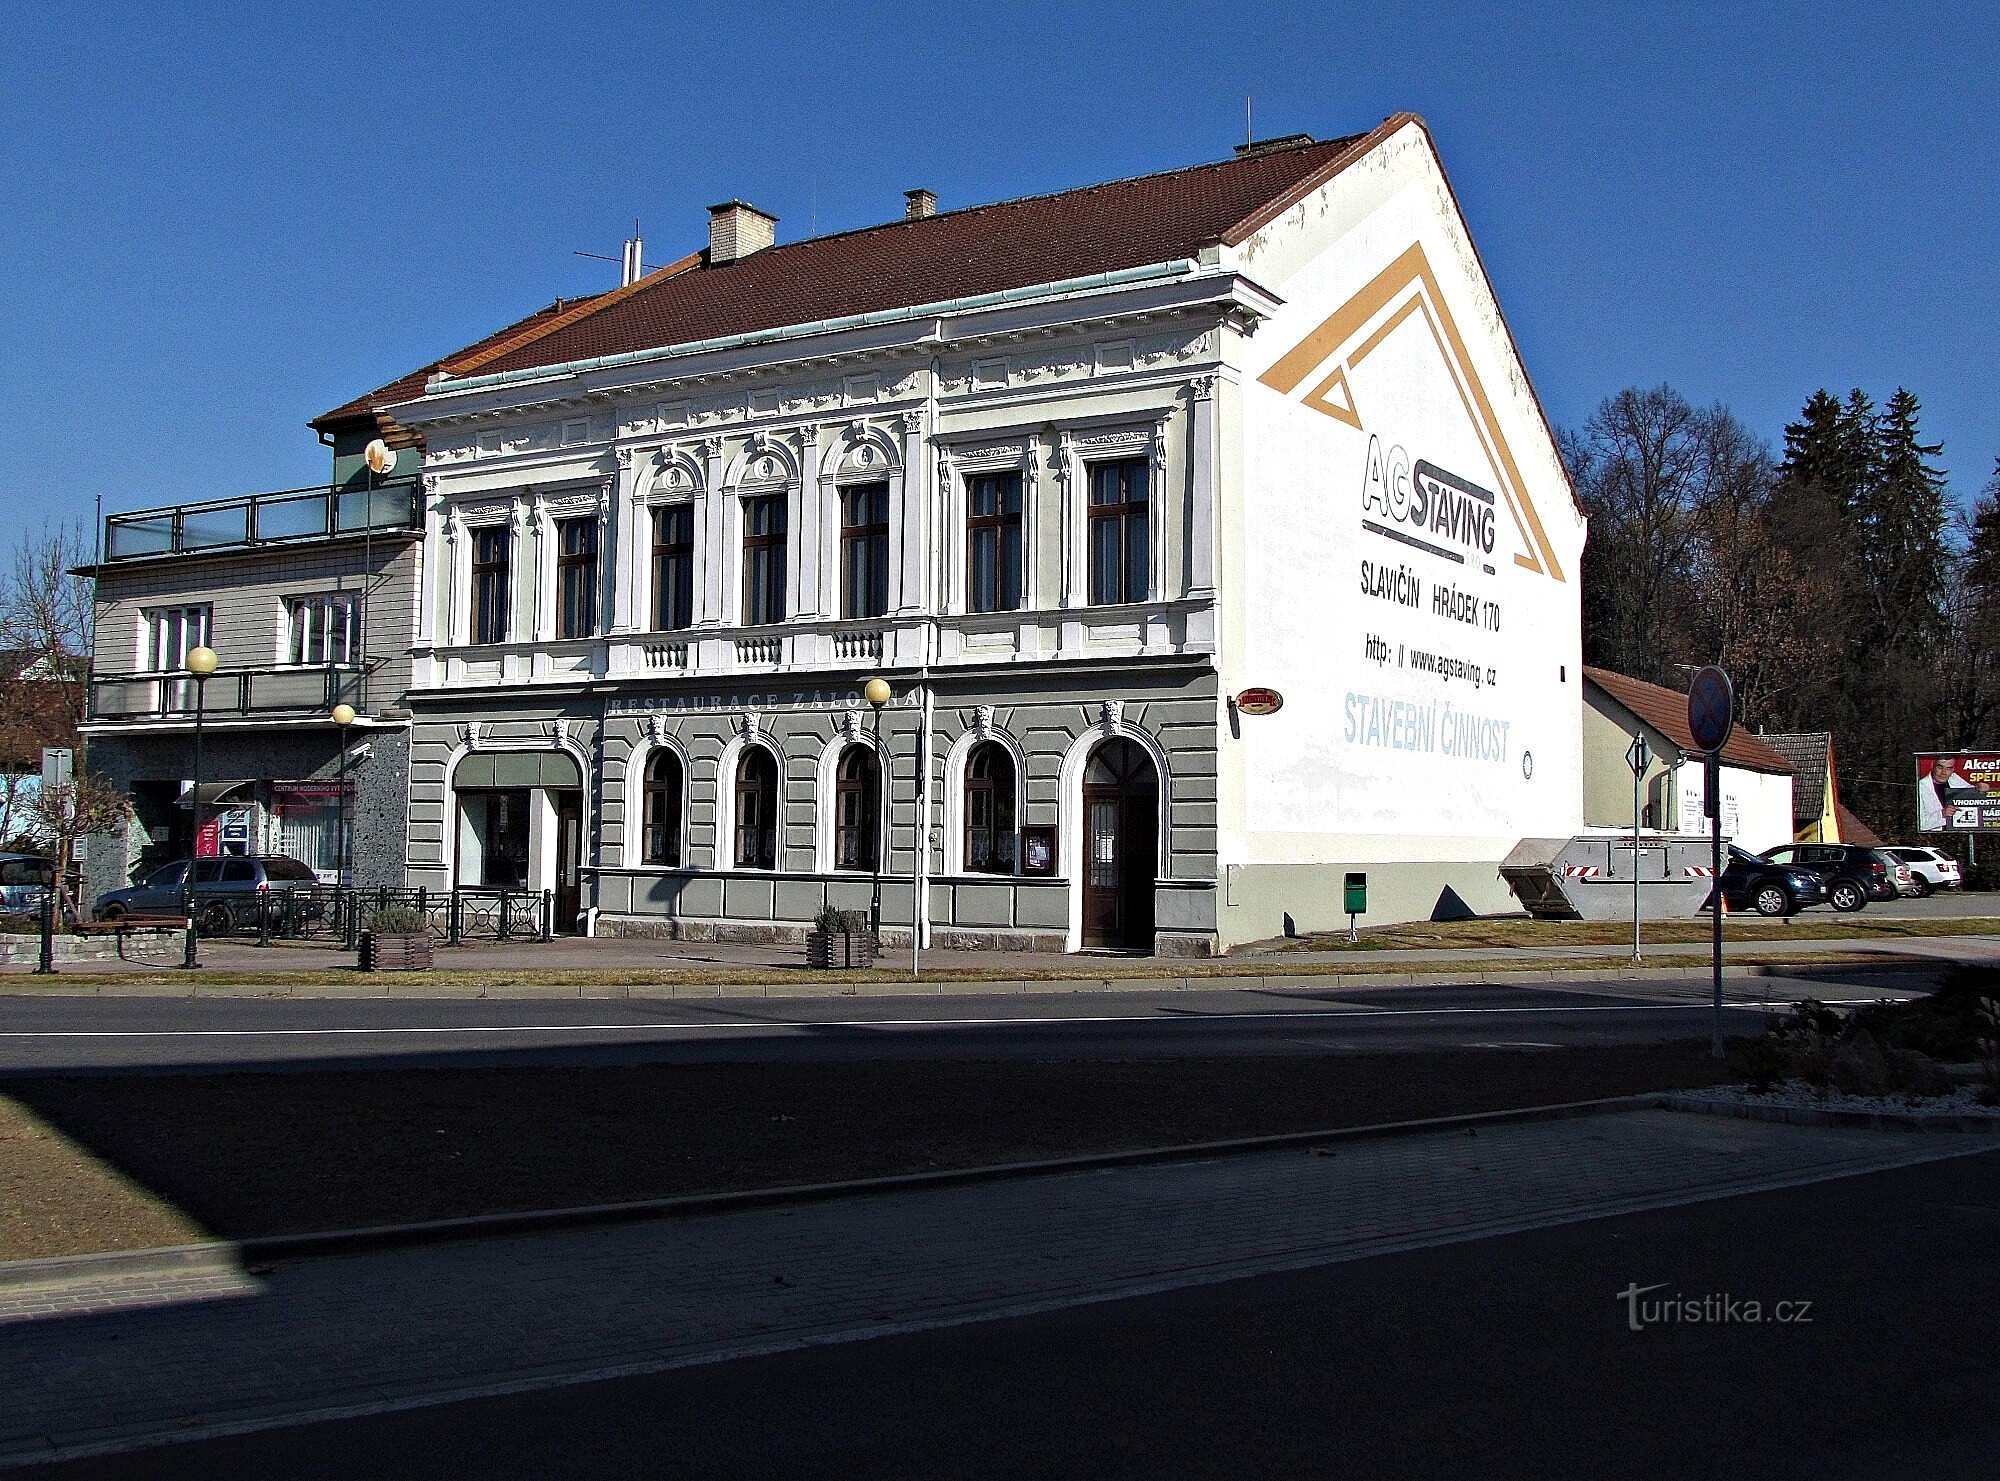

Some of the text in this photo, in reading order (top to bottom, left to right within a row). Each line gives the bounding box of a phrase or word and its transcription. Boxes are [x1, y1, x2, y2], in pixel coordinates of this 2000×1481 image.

[1361, 560, 1500, 632] SLAVIČÍN HRÁDEK 170
[610, 689, 919, 715] RESTAURACE ZÁLONA
[1344, 691, 1511, 763] STAVEBNÍ ČINNOST
